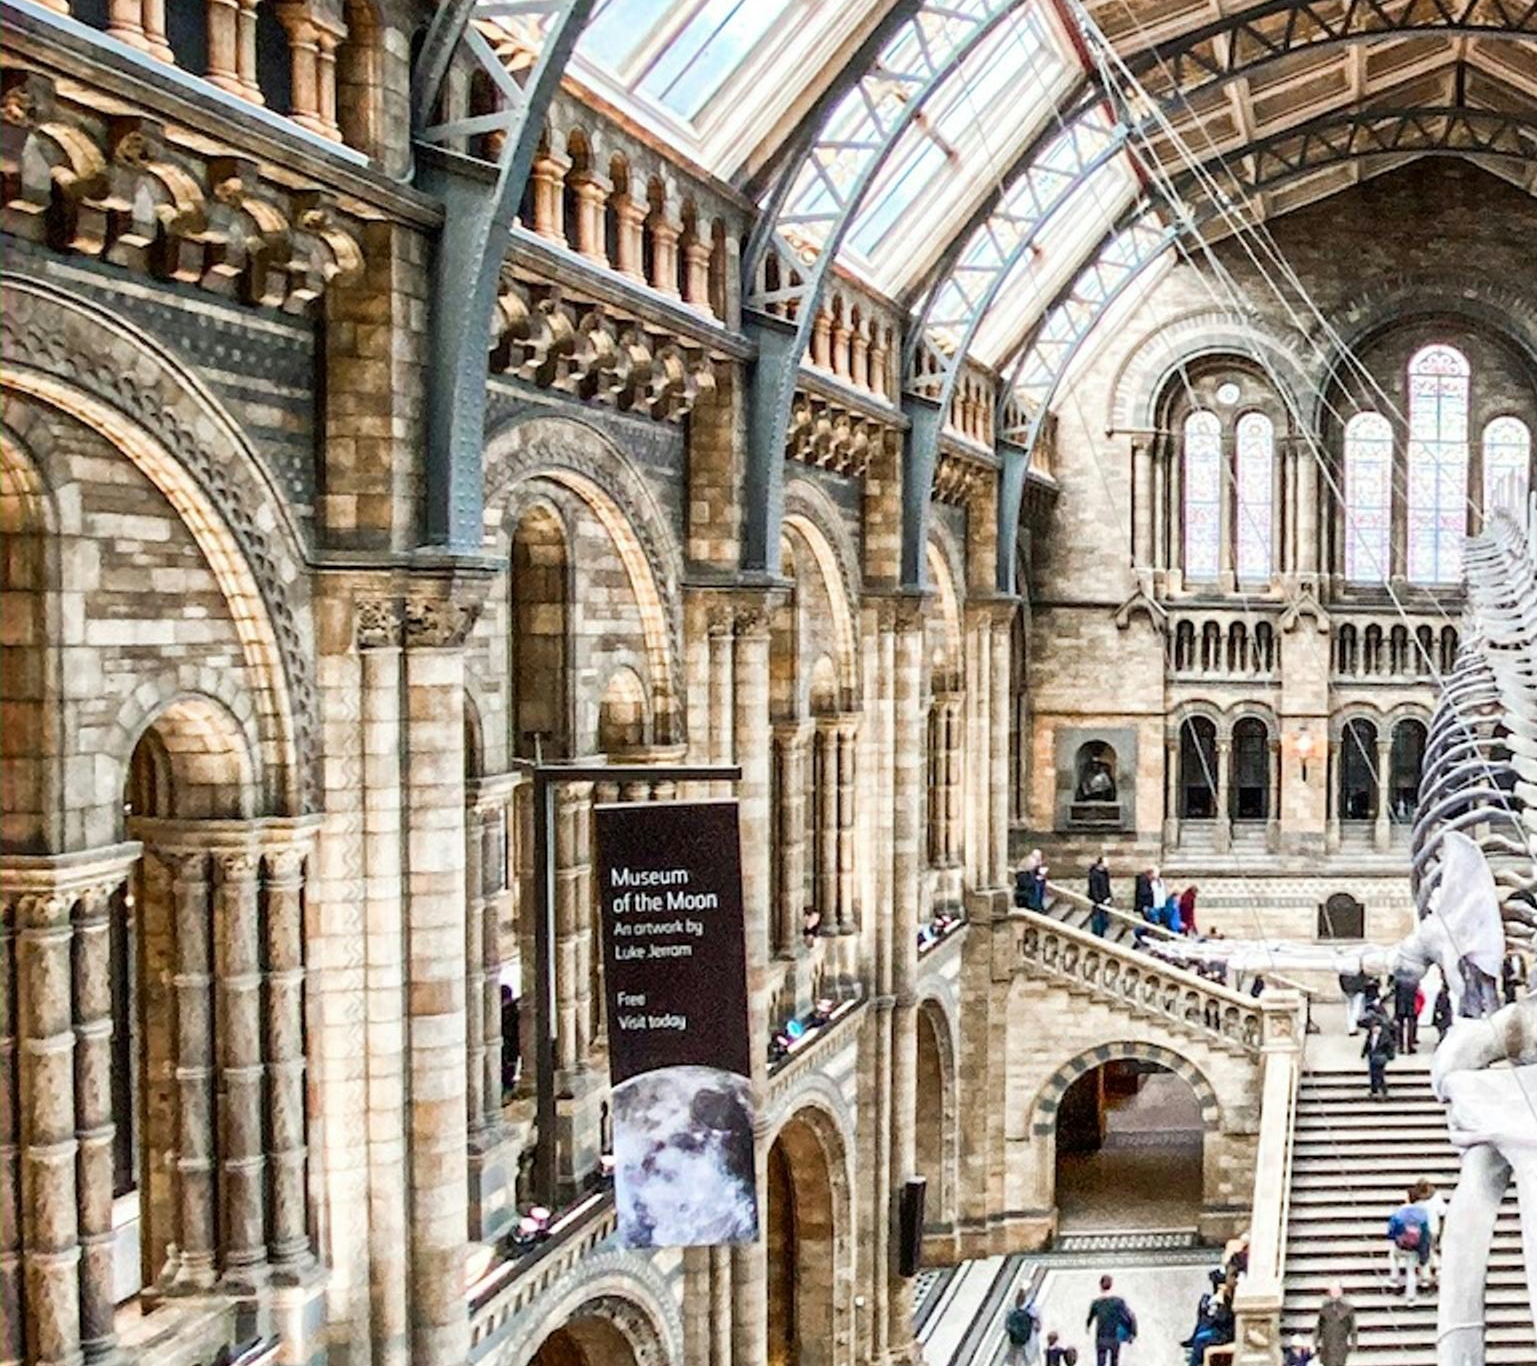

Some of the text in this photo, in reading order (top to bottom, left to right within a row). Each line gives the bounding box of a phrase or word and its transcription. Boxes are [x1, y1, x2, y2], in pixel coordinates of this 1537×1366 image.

[611, 868, 688, 886] Museum
[612, 890, 718, 913] of the Moon
[613, 918, 704, 937] An artwork by
[614, 943, 692, 961] Luke Jerram
[617, 991, 646, 1007] Free
[617, 1013, 686, 1031] Visit today
